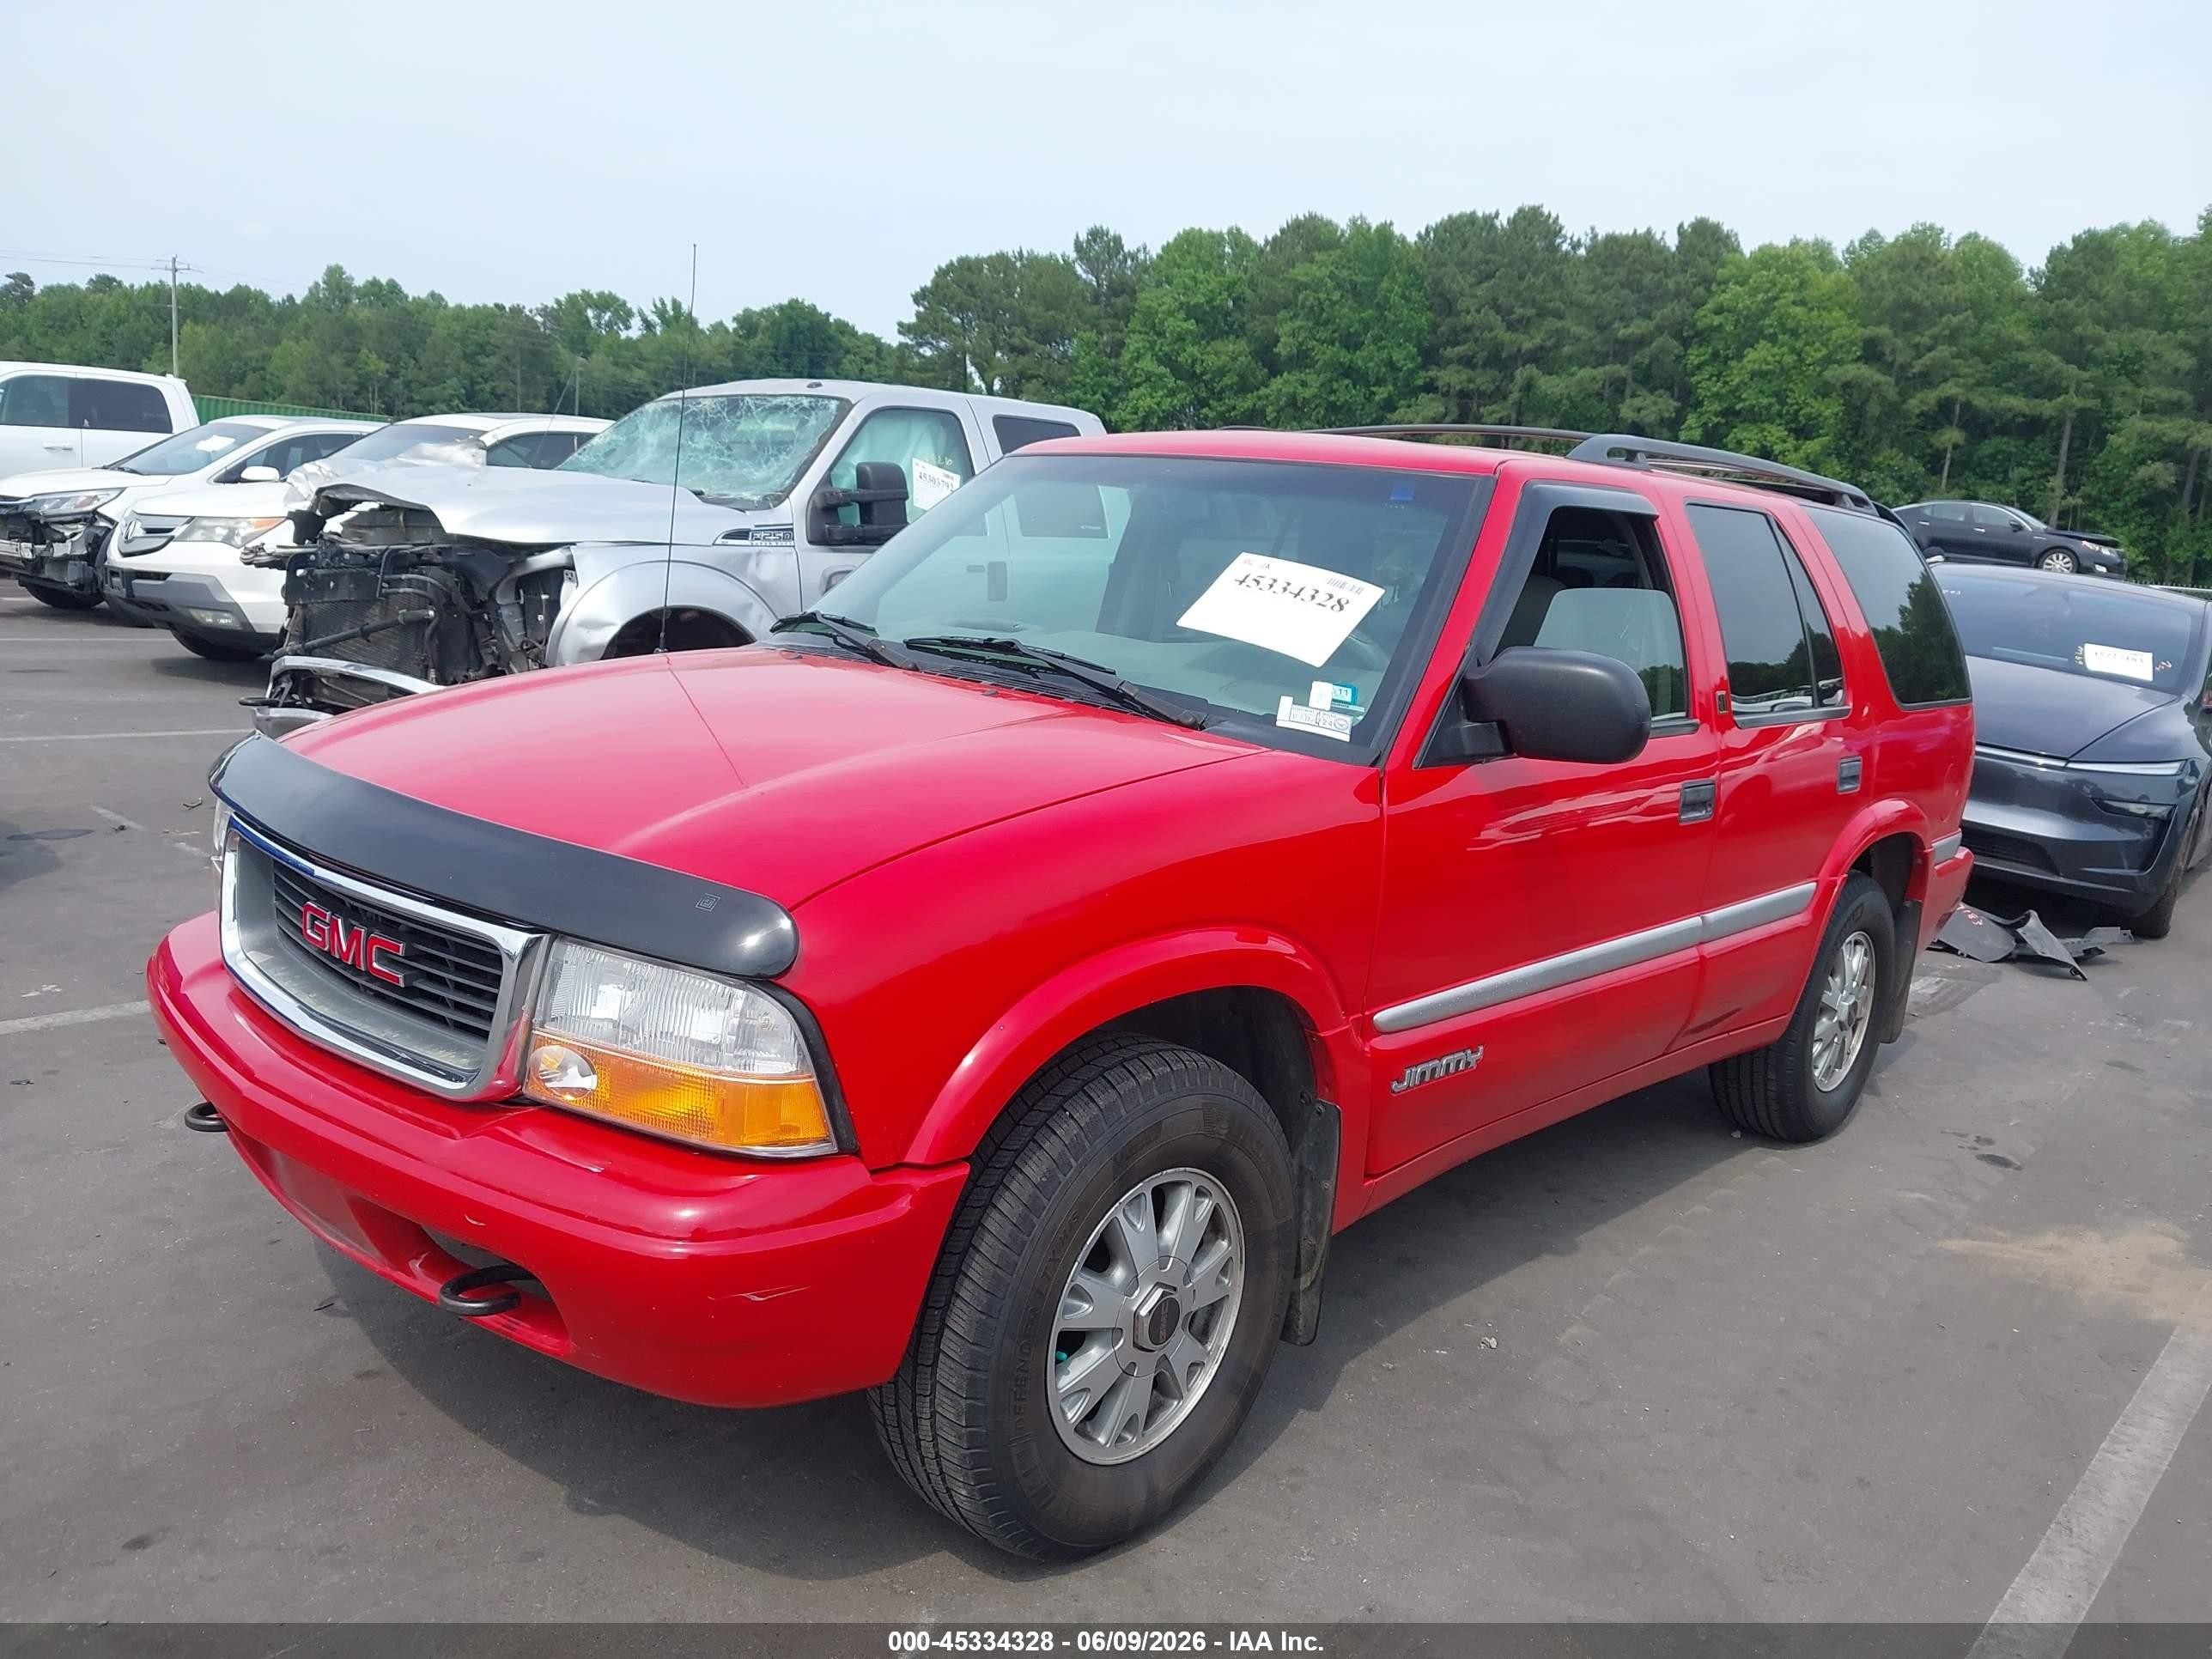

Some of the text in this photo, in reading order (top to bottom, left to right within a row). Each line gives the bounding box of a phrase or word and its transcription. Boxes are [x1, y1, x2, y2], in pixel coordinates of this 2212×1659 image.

[1233, 573, 1350, 613] 45334328
[302, 901, 406, 988] GMC
[1391, 1044, 1484, 1092] JIMMY
